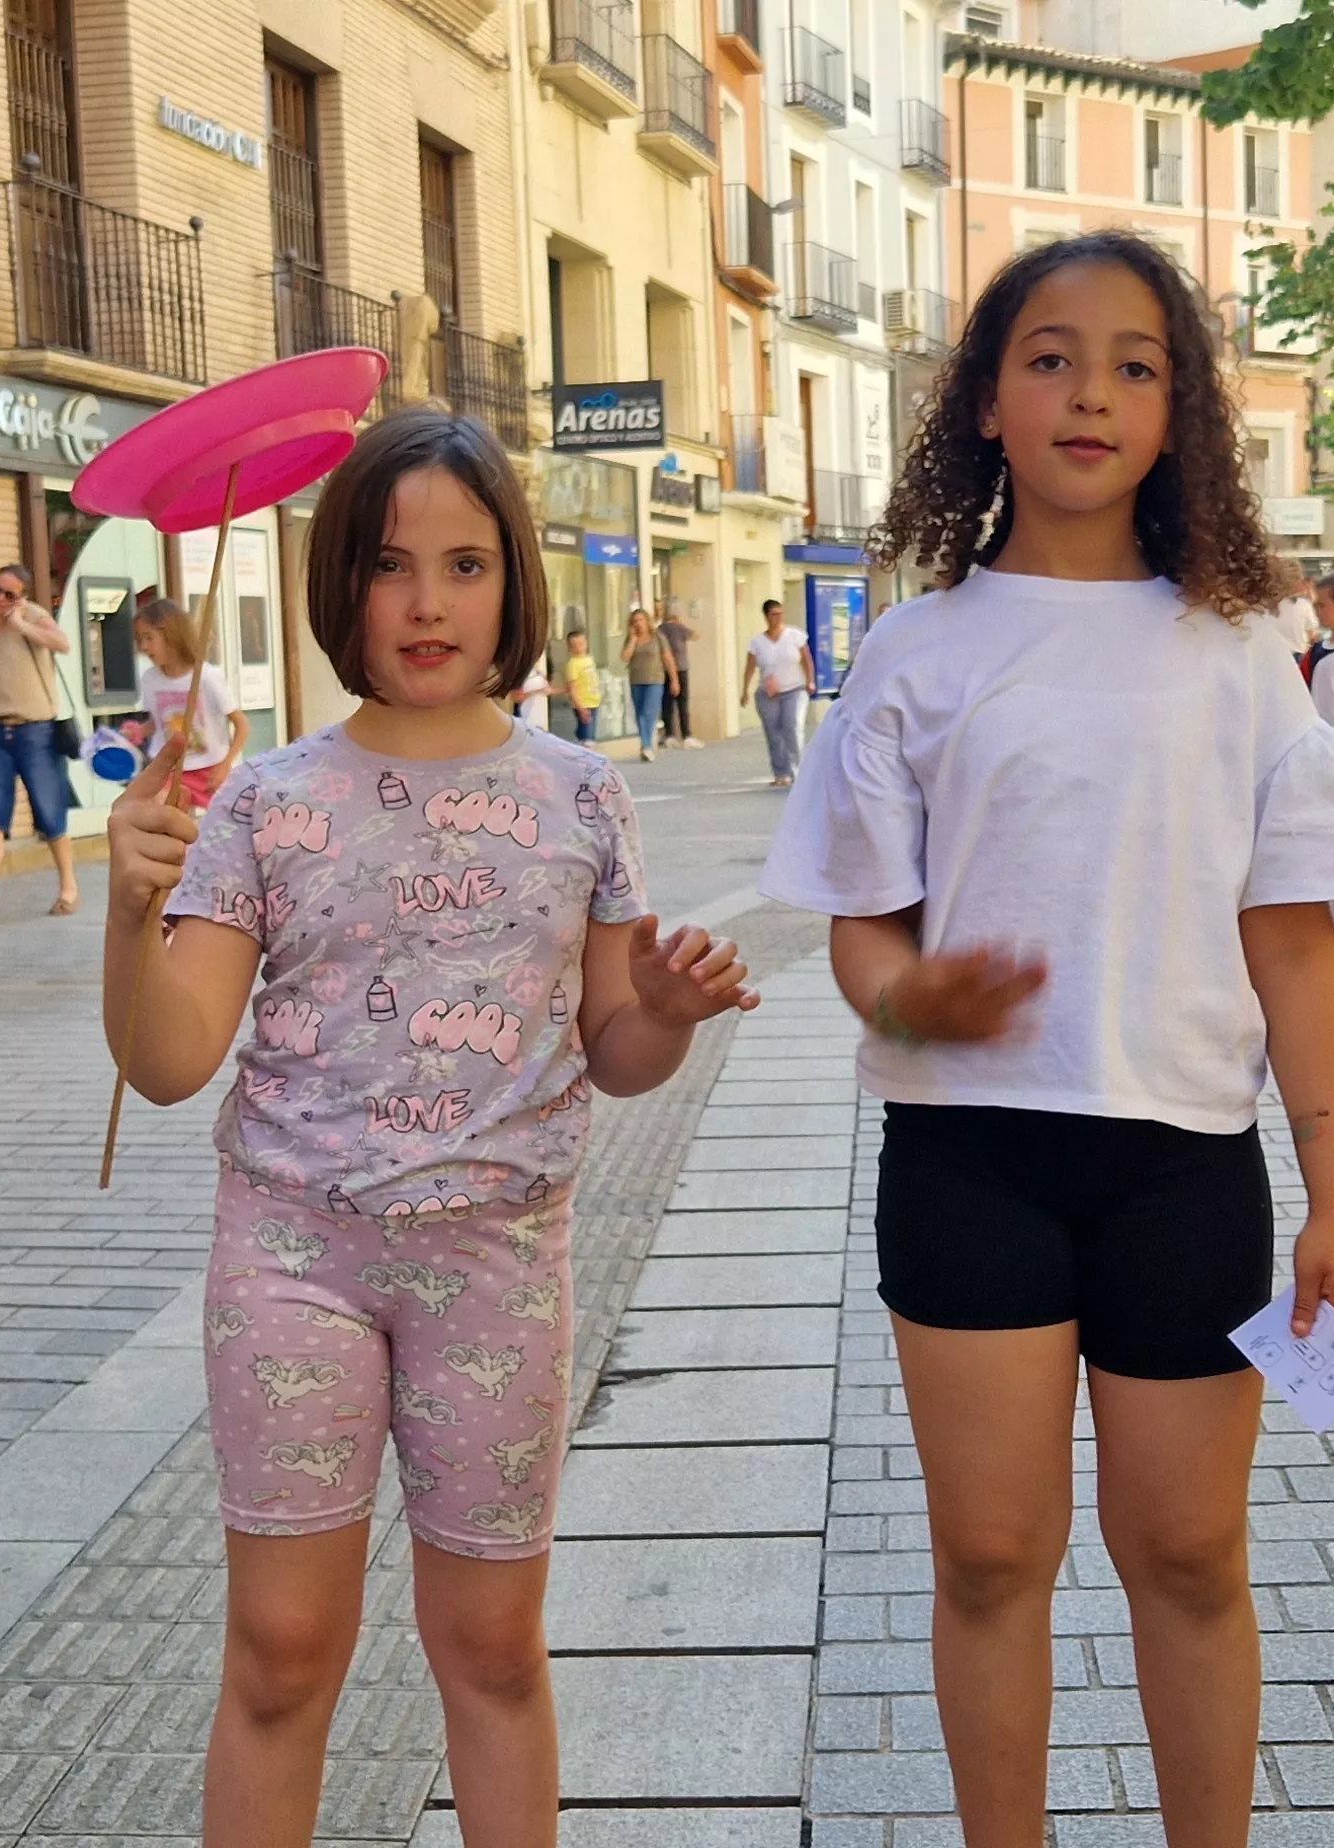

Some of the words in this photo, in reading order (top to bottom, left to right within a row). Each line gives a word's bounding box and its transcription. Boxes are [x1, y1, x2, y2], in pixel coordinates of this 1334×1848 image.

[556, 402, 661, 433] Arenas
[423, 789, 539, 848] COOL
[391, 866, 507, 919] LOVE
[408, 998, 523, 1065] COOL
[366, 1089, 473, 1133] LOVE
